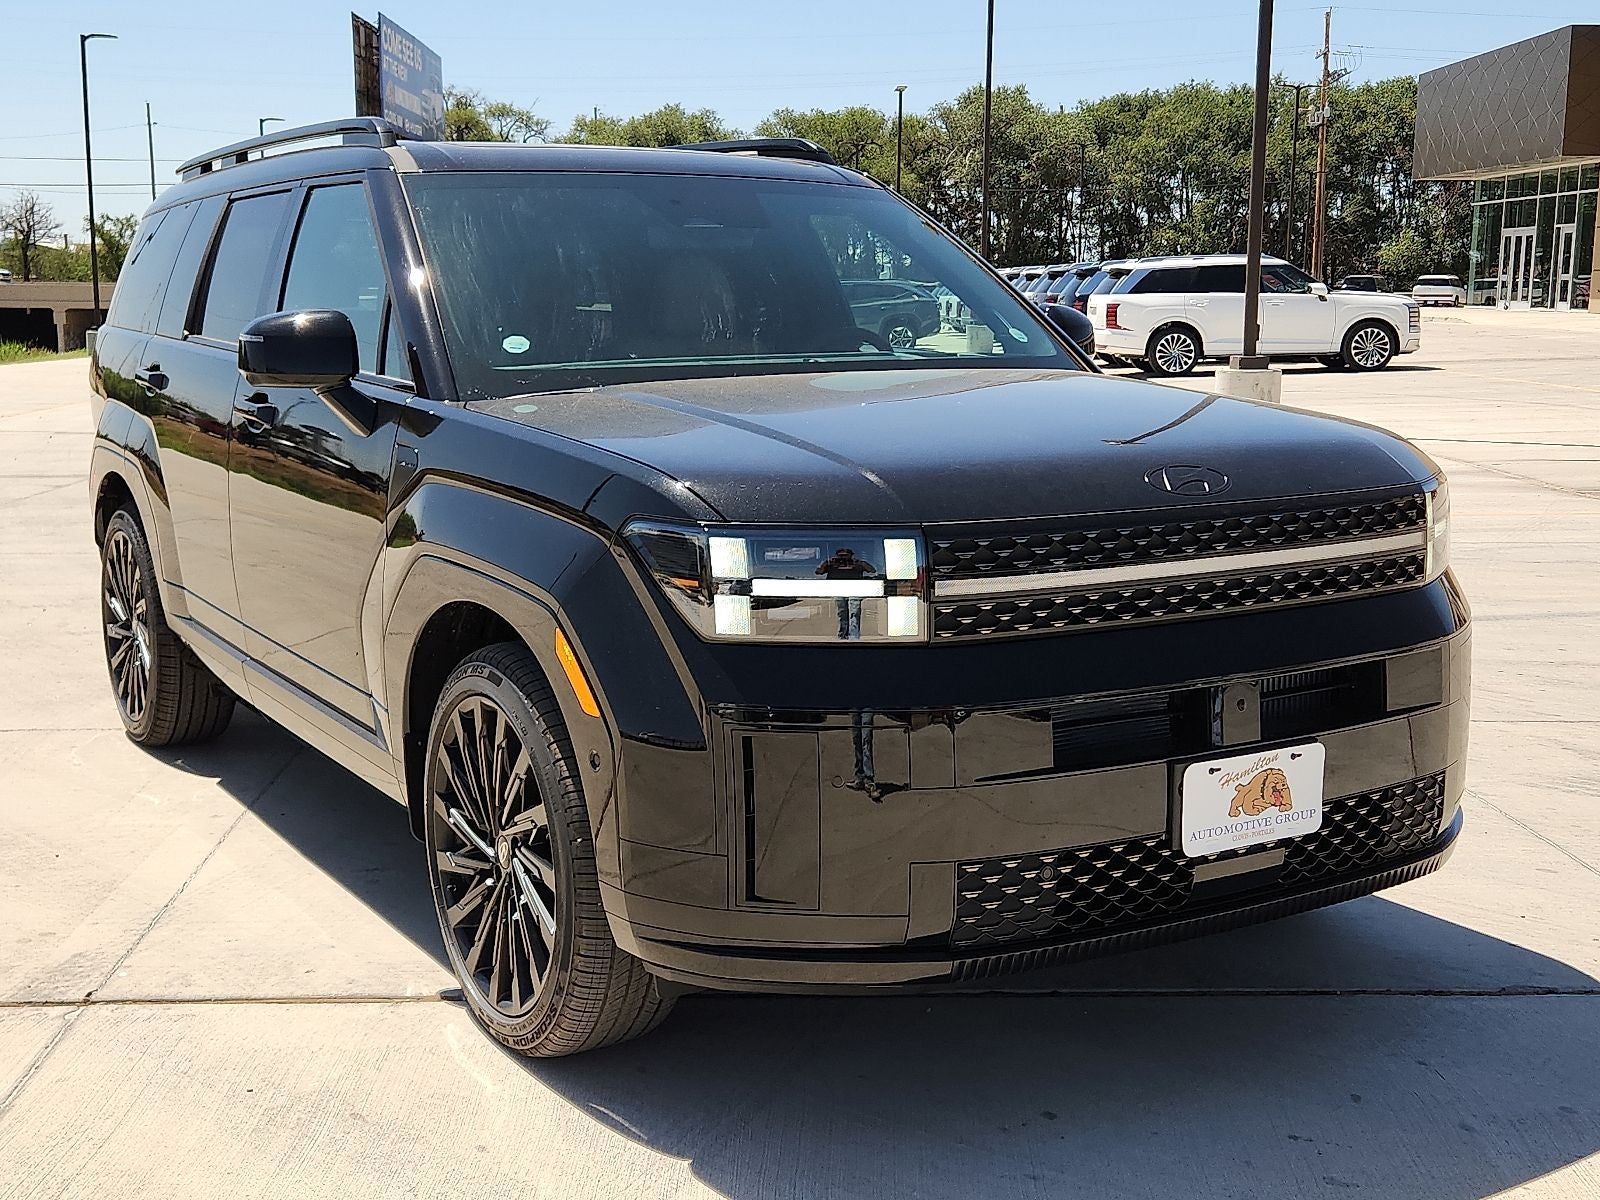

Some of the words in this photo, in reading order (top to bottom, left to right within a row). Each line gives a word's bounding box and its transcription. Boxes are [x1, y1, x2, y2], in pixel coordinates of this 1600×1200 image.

[1218, 752, 1280, 789] Hamilton
[1190, 817, 1272, 842] AUTOMOTIVE
[1275, 808, 1317, 825] GROUP
[513, 1003, 558, 1047] SCORPION
